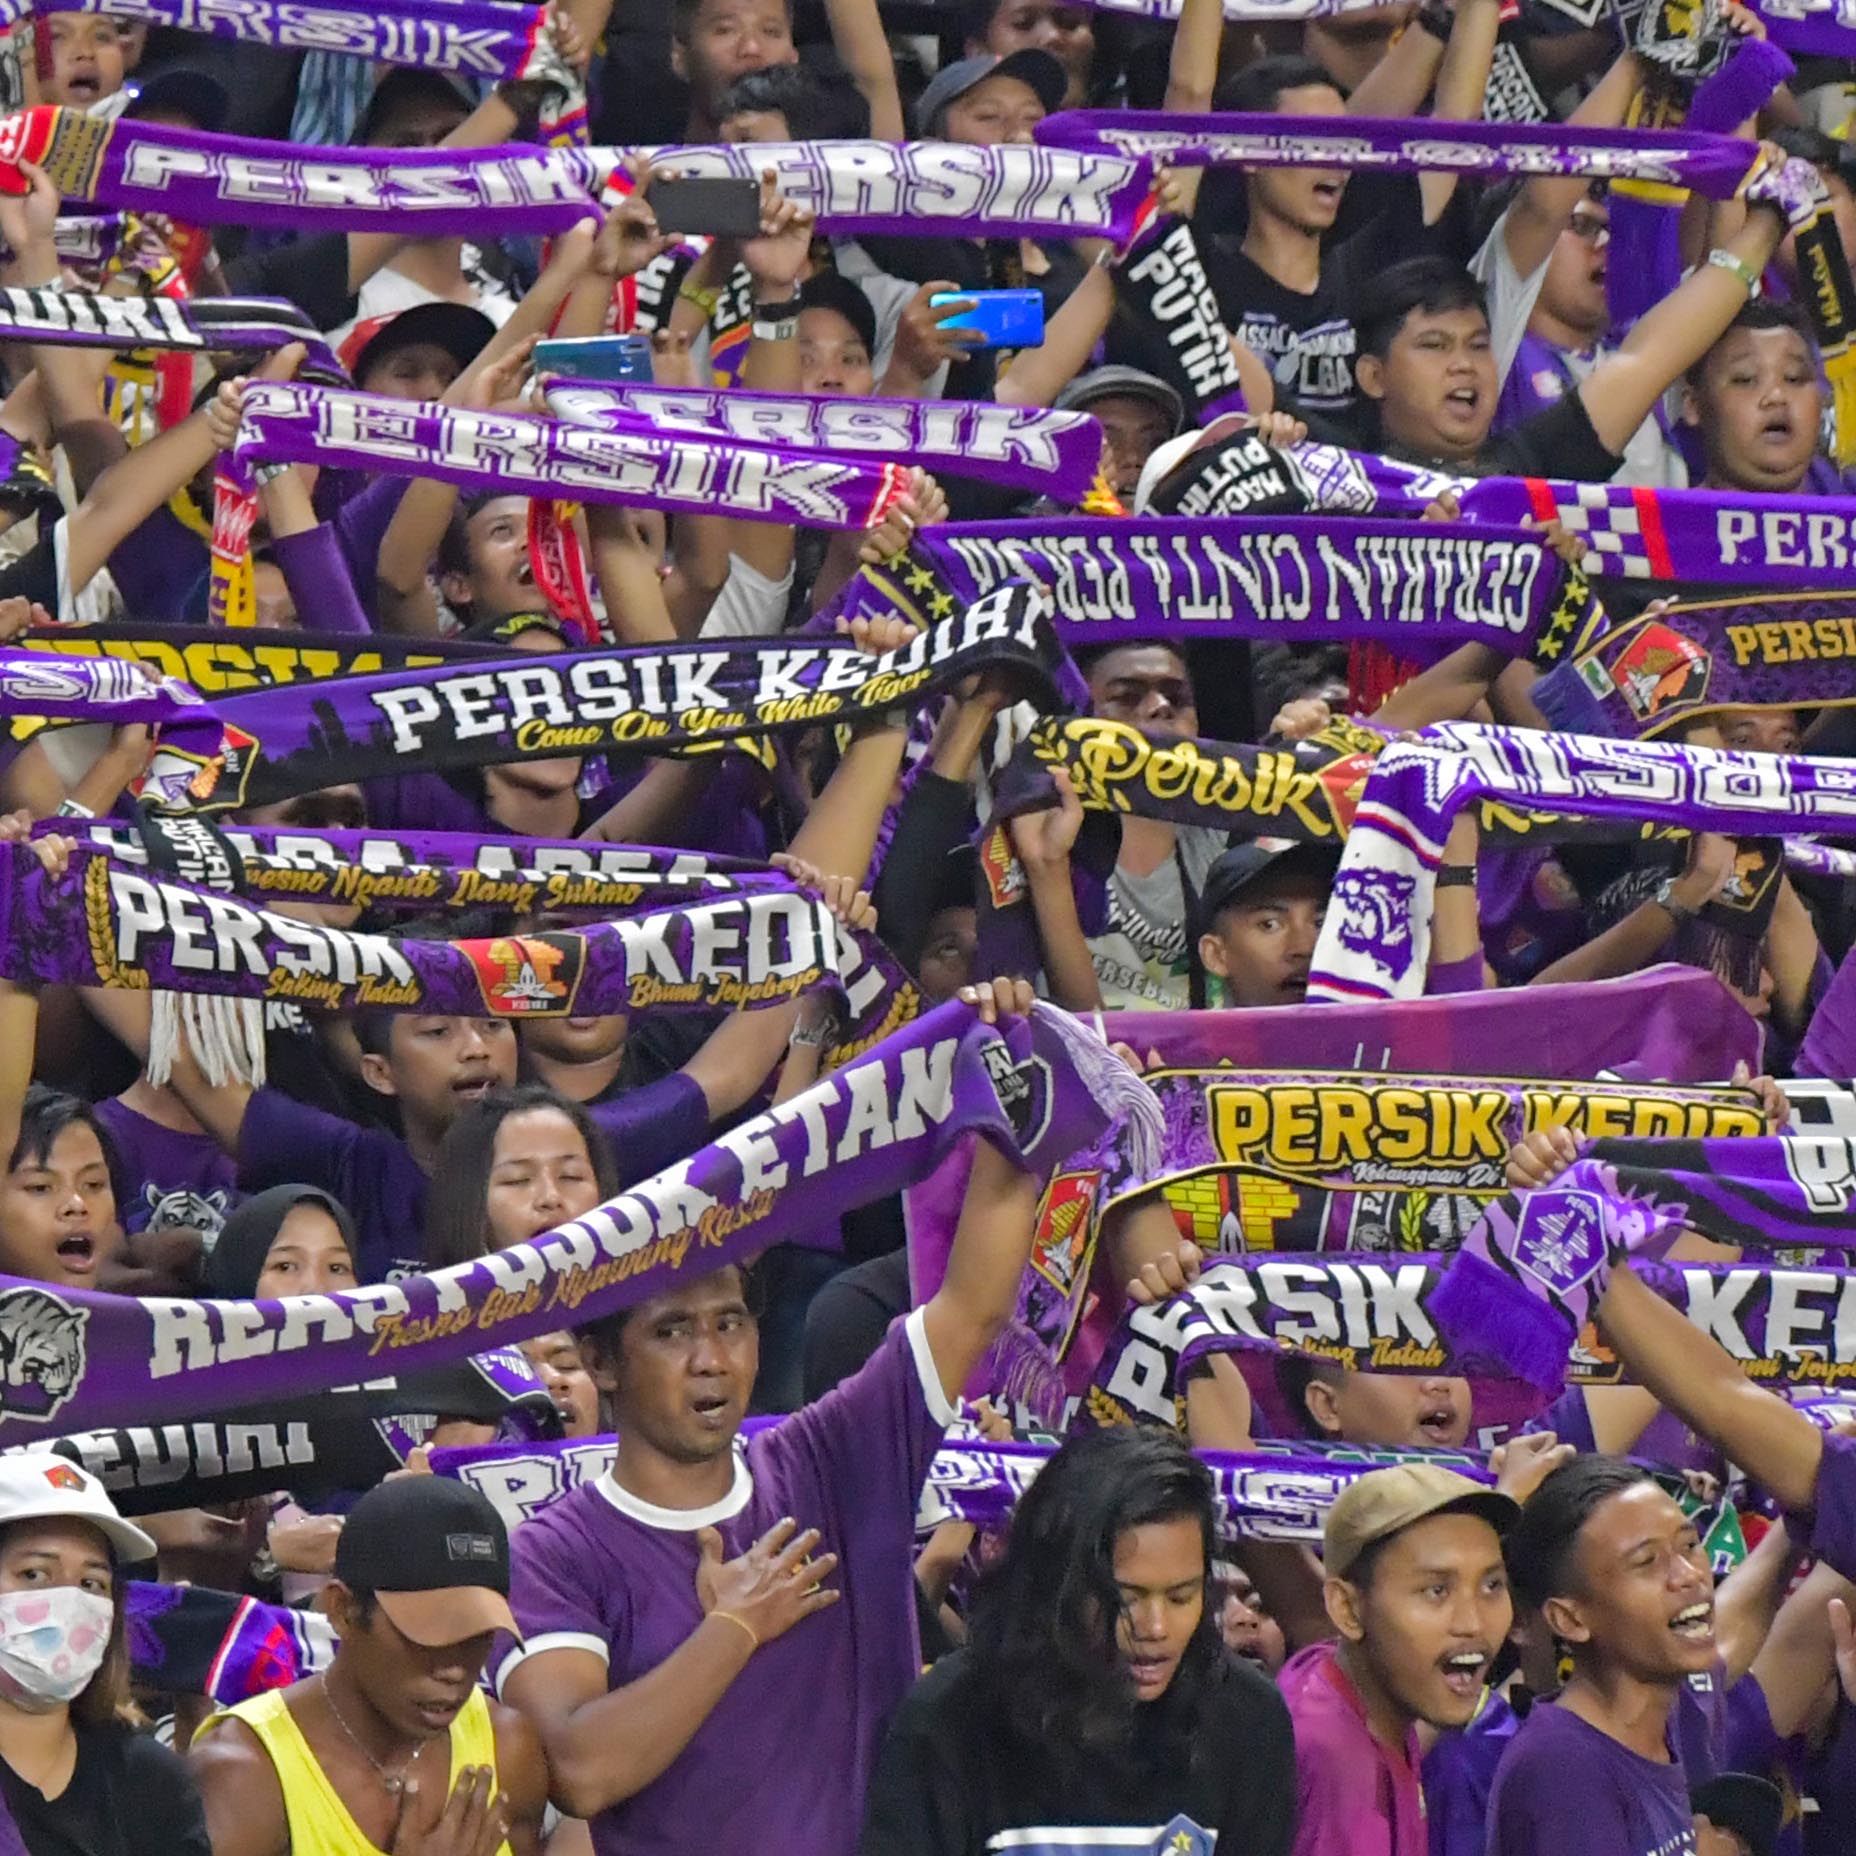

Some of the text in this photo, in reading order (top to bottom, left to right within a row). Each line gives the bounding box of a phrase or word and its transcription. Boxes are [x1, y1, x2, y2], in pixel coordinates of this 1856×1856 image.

[122, 143, 582, 210] PERSIK
[678, 143, 1135, 222] ERSIK
[1129, 248, 1210, 396] PUTIH
[246, 384, 854, 518] PERSIK
[550, 382, 1083, 467] ERSIK
[1141, 536, 1541, 634] GERAKAN CINTA
[379, 655, 732, 752] PERSIK
[517, 670, 928, 750] Come On You Tiger
[1066, 719, 1333, 834] Persik
[114, 874, 419, 986] PERSIK
[247, 863, 342, 900] resno
[352, 866, 441, 904] Nganti
[544, 874, 641, 906] Sukmo
[263, 969, 421, 1006] Saking Tlatah
[625, 966, 821, 1006] Bhumi Joyoboyo
[1214, 1092, 1509, 1165] PERSIK
[149, 1287, 411, 1379] REAS
[742, 1040, 961, 1201] ETAN
[1353, 1162, 1461, 1188] Kebanggaan
[368, 1304, 471, 1355] Tresno
[699, 1188, 776, 1248] Kasta
[1107, 1262, 1440, 1425] PERSIK
